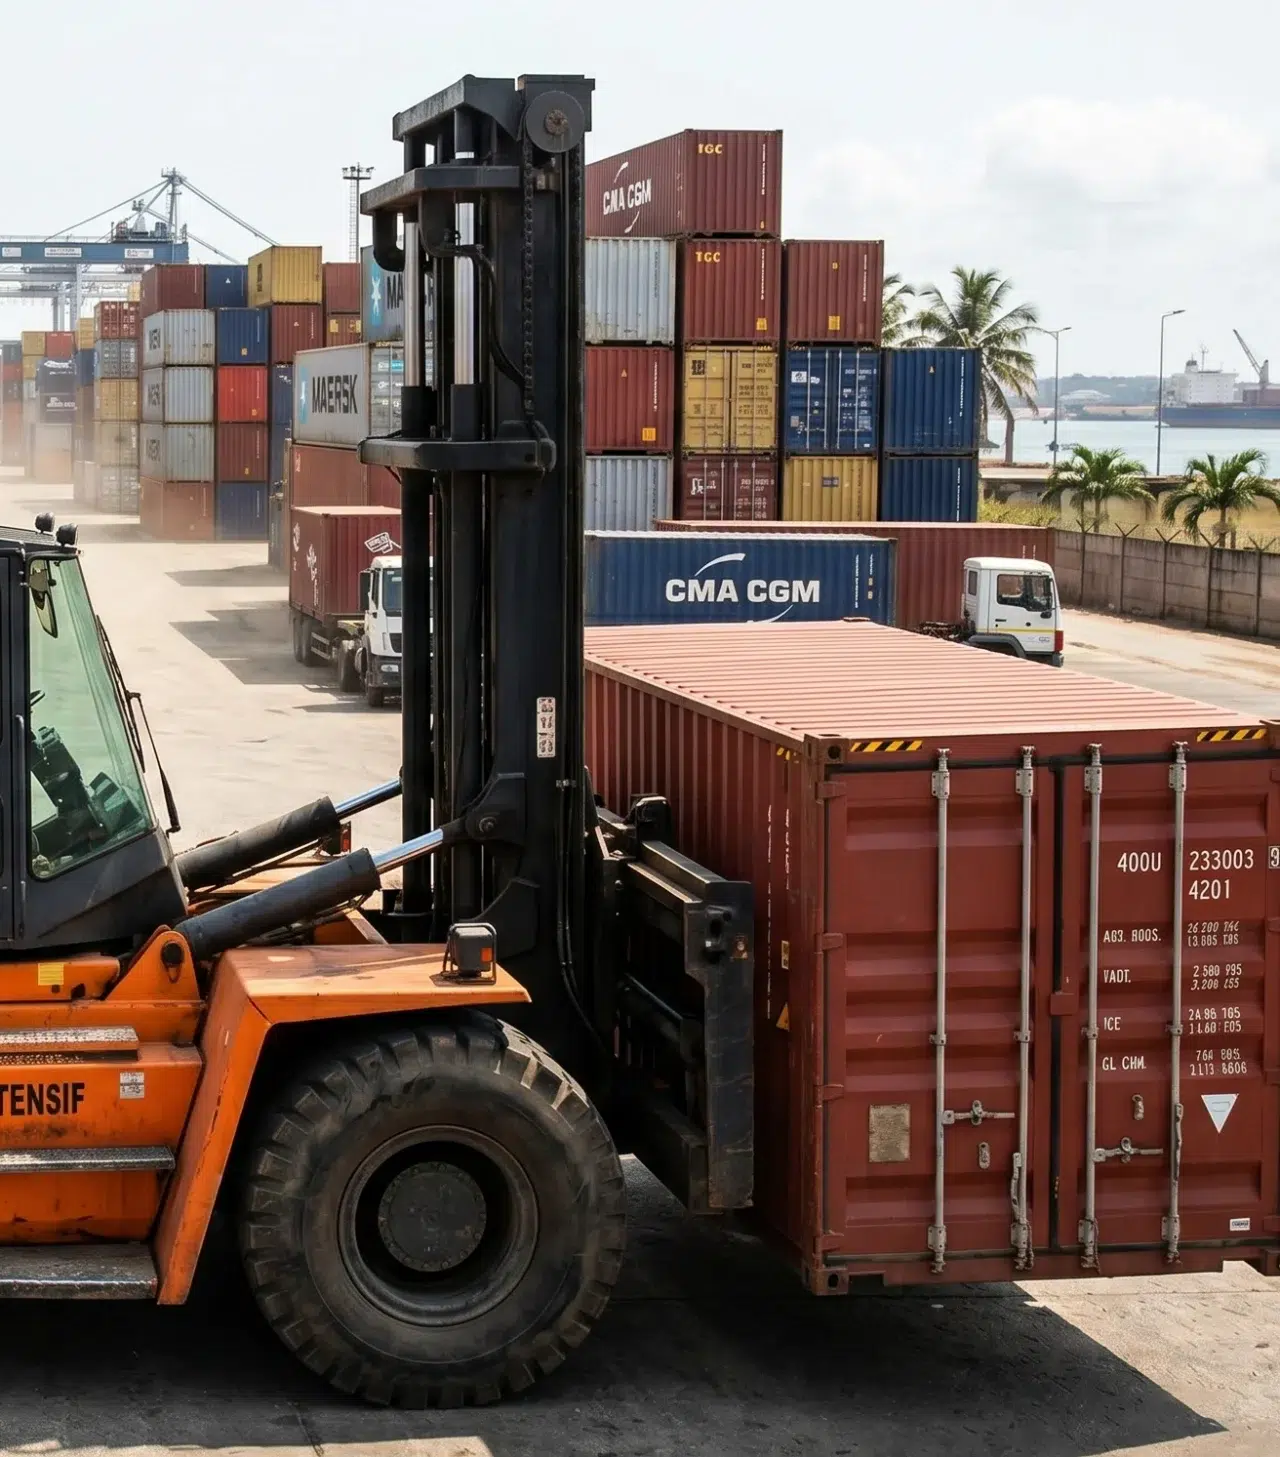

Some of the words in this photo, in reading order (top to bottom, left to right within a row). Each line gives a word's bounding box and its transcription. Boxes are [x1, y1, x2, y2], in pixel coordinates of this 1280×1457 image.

[627, 178, 652, 209] CGM
[665, 579, 739, 603] CMA
[747, 579, 820, 603] CGM
[1189, 848, 1254, 871] 233003
[1188, 879, 1231, 900] 4201
